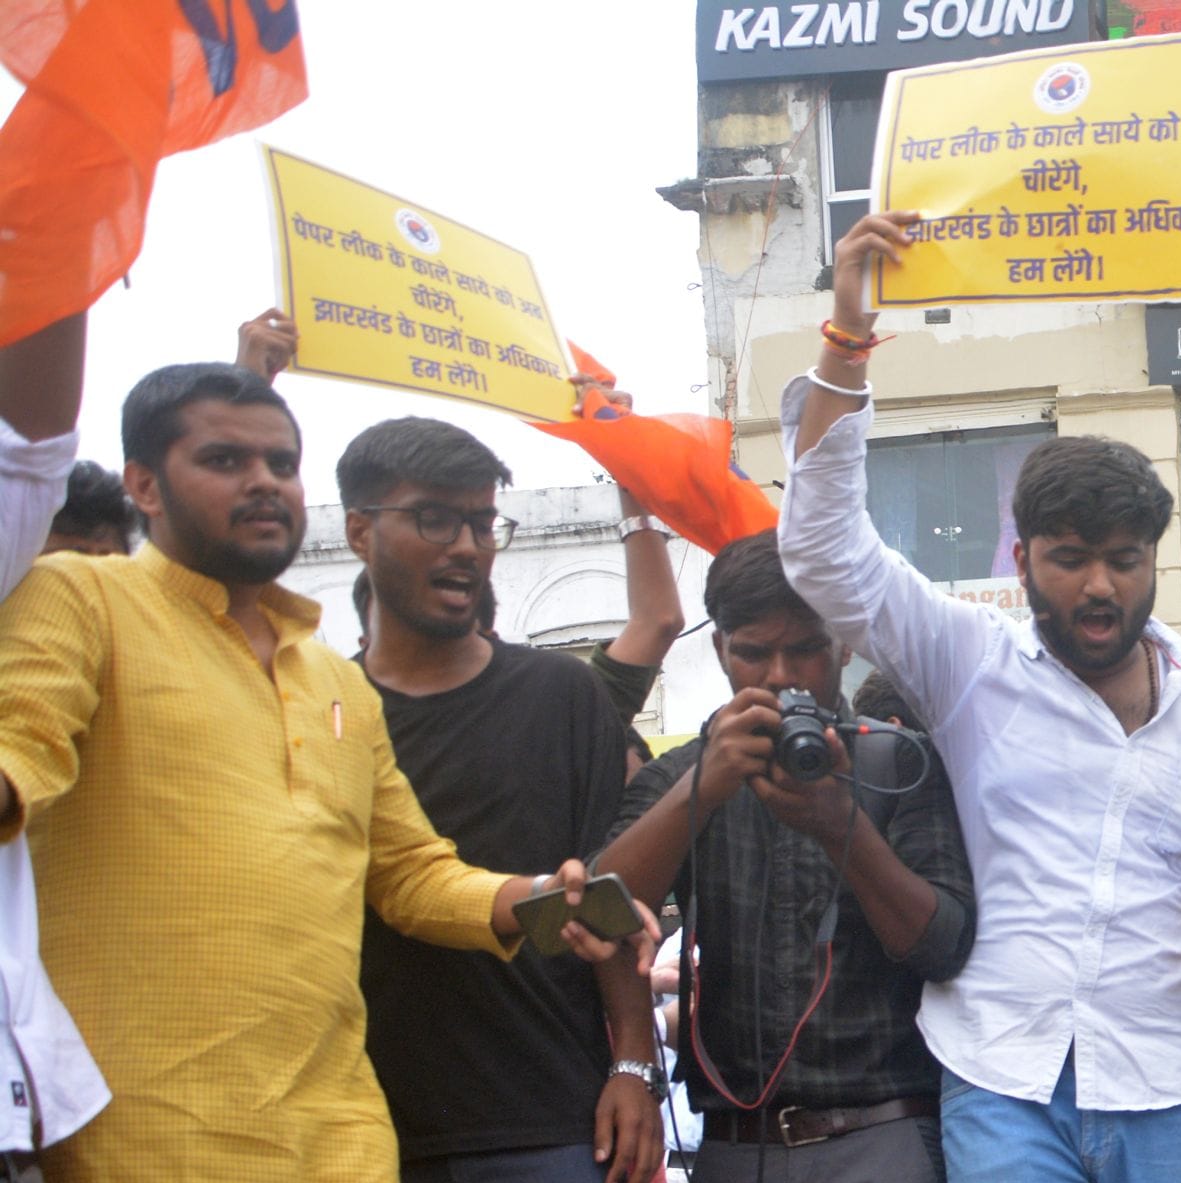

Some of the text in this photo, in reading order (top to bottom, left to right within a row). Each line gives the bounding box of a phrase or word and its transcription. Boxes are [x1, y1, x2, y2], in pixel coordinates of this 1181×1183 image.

[715, 0, 1075, 51] KAZMI SOUND
[901, 137, 945, 163] पेपर
[950, 127, 1002, 157] लीक
[1006, 123, 1029, 150] के
[1034, 117, 1087, 147] काले
[1091, 113, 1143, 144] साये
[1148, 111, 1181, 142] को
[1021, 159, 1088, 195] चीरेंगे,
[905, 208, 993, 242] झारखंड
[997, 206, 1020, 238] के
[1025, 203, 1083, 238] छात्रों
[1086, 209, 1117, 235] का
[291, 211, 335, 249] पेपर
[336, 229, 384, 262] लीक
[386, 241, 406, 269] के
[407, 259, 453, 286] काले
[452, 274, 492, 299] साये
[491, 285, 516, 310] को
[1006, 258, 1045, 283] हम
[408, 283, 464, 322] चीरेंगे,
[311, 297, 562, 380] झारखंड के छात्रों का अधिकार
[408, 355, 442, 382] हम
